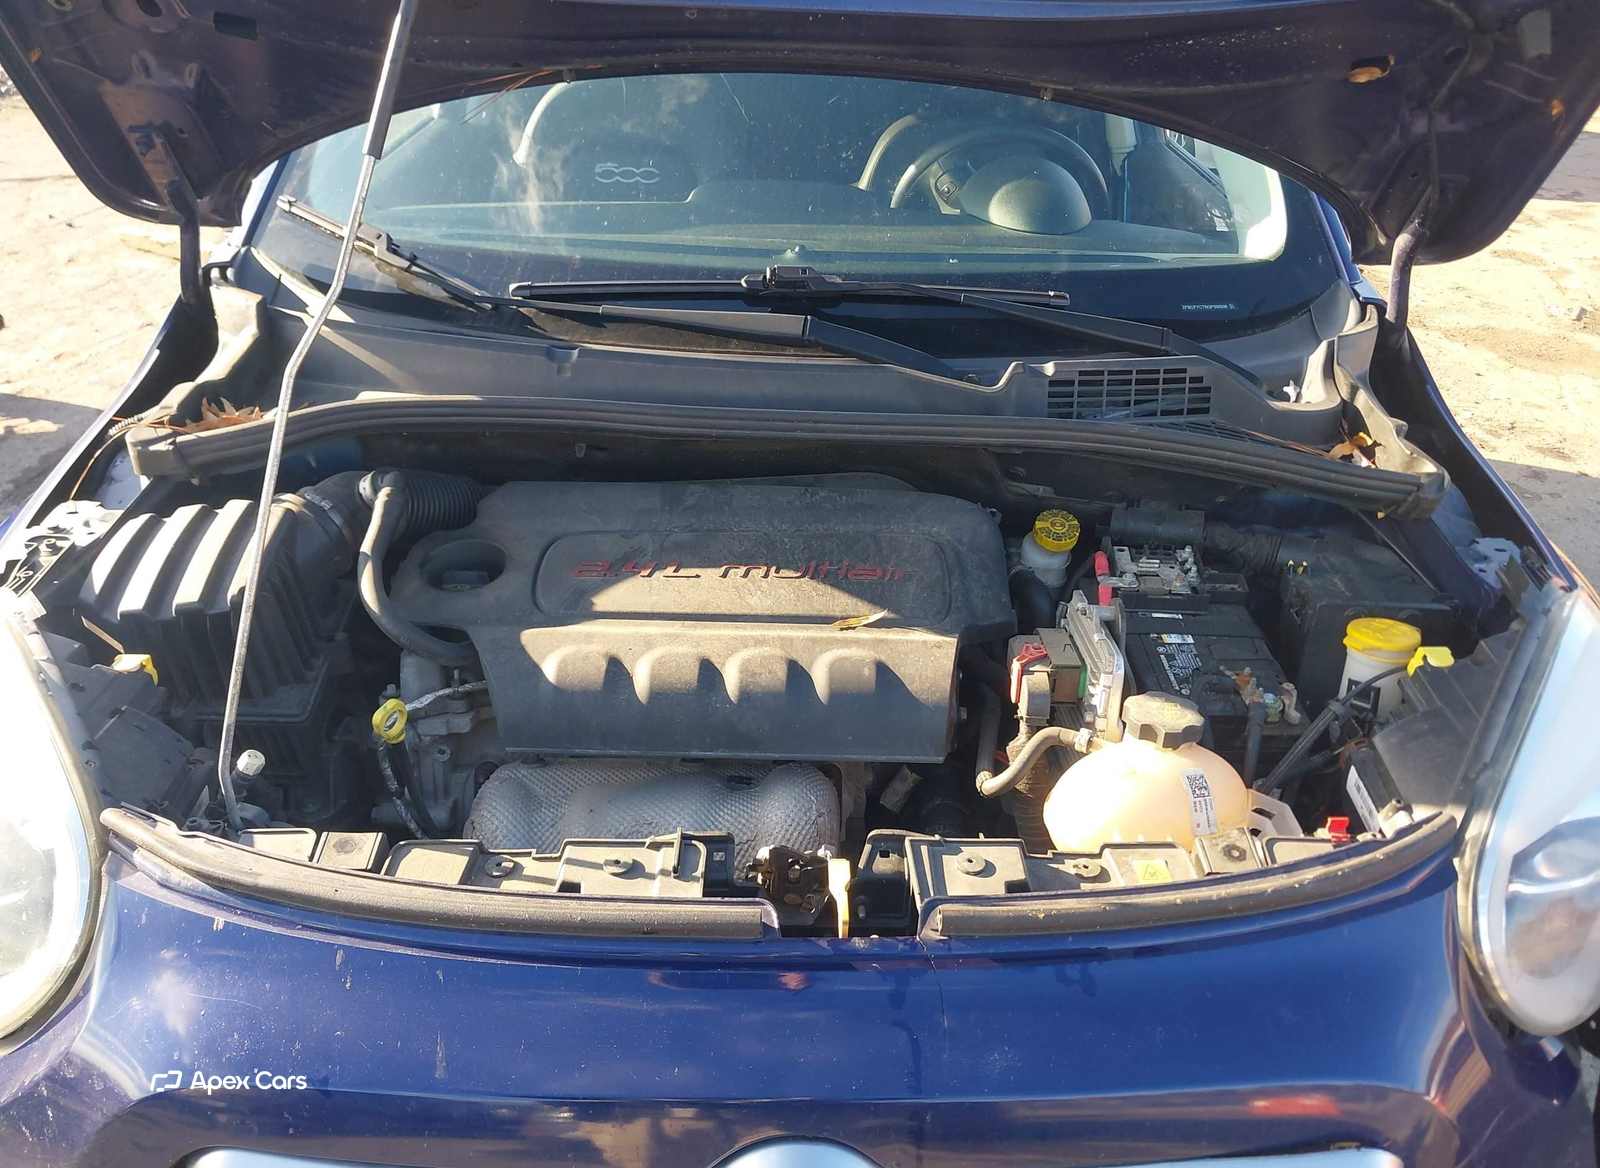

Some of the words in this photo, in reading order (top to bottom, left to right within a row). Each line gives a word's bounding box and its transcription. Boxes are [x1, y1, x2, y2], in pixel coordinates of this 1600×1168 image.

[594, 163, 661, 183] 500
[571, 559, 702, 579] 2.4L
[717, 558, 916, 581] multiair
